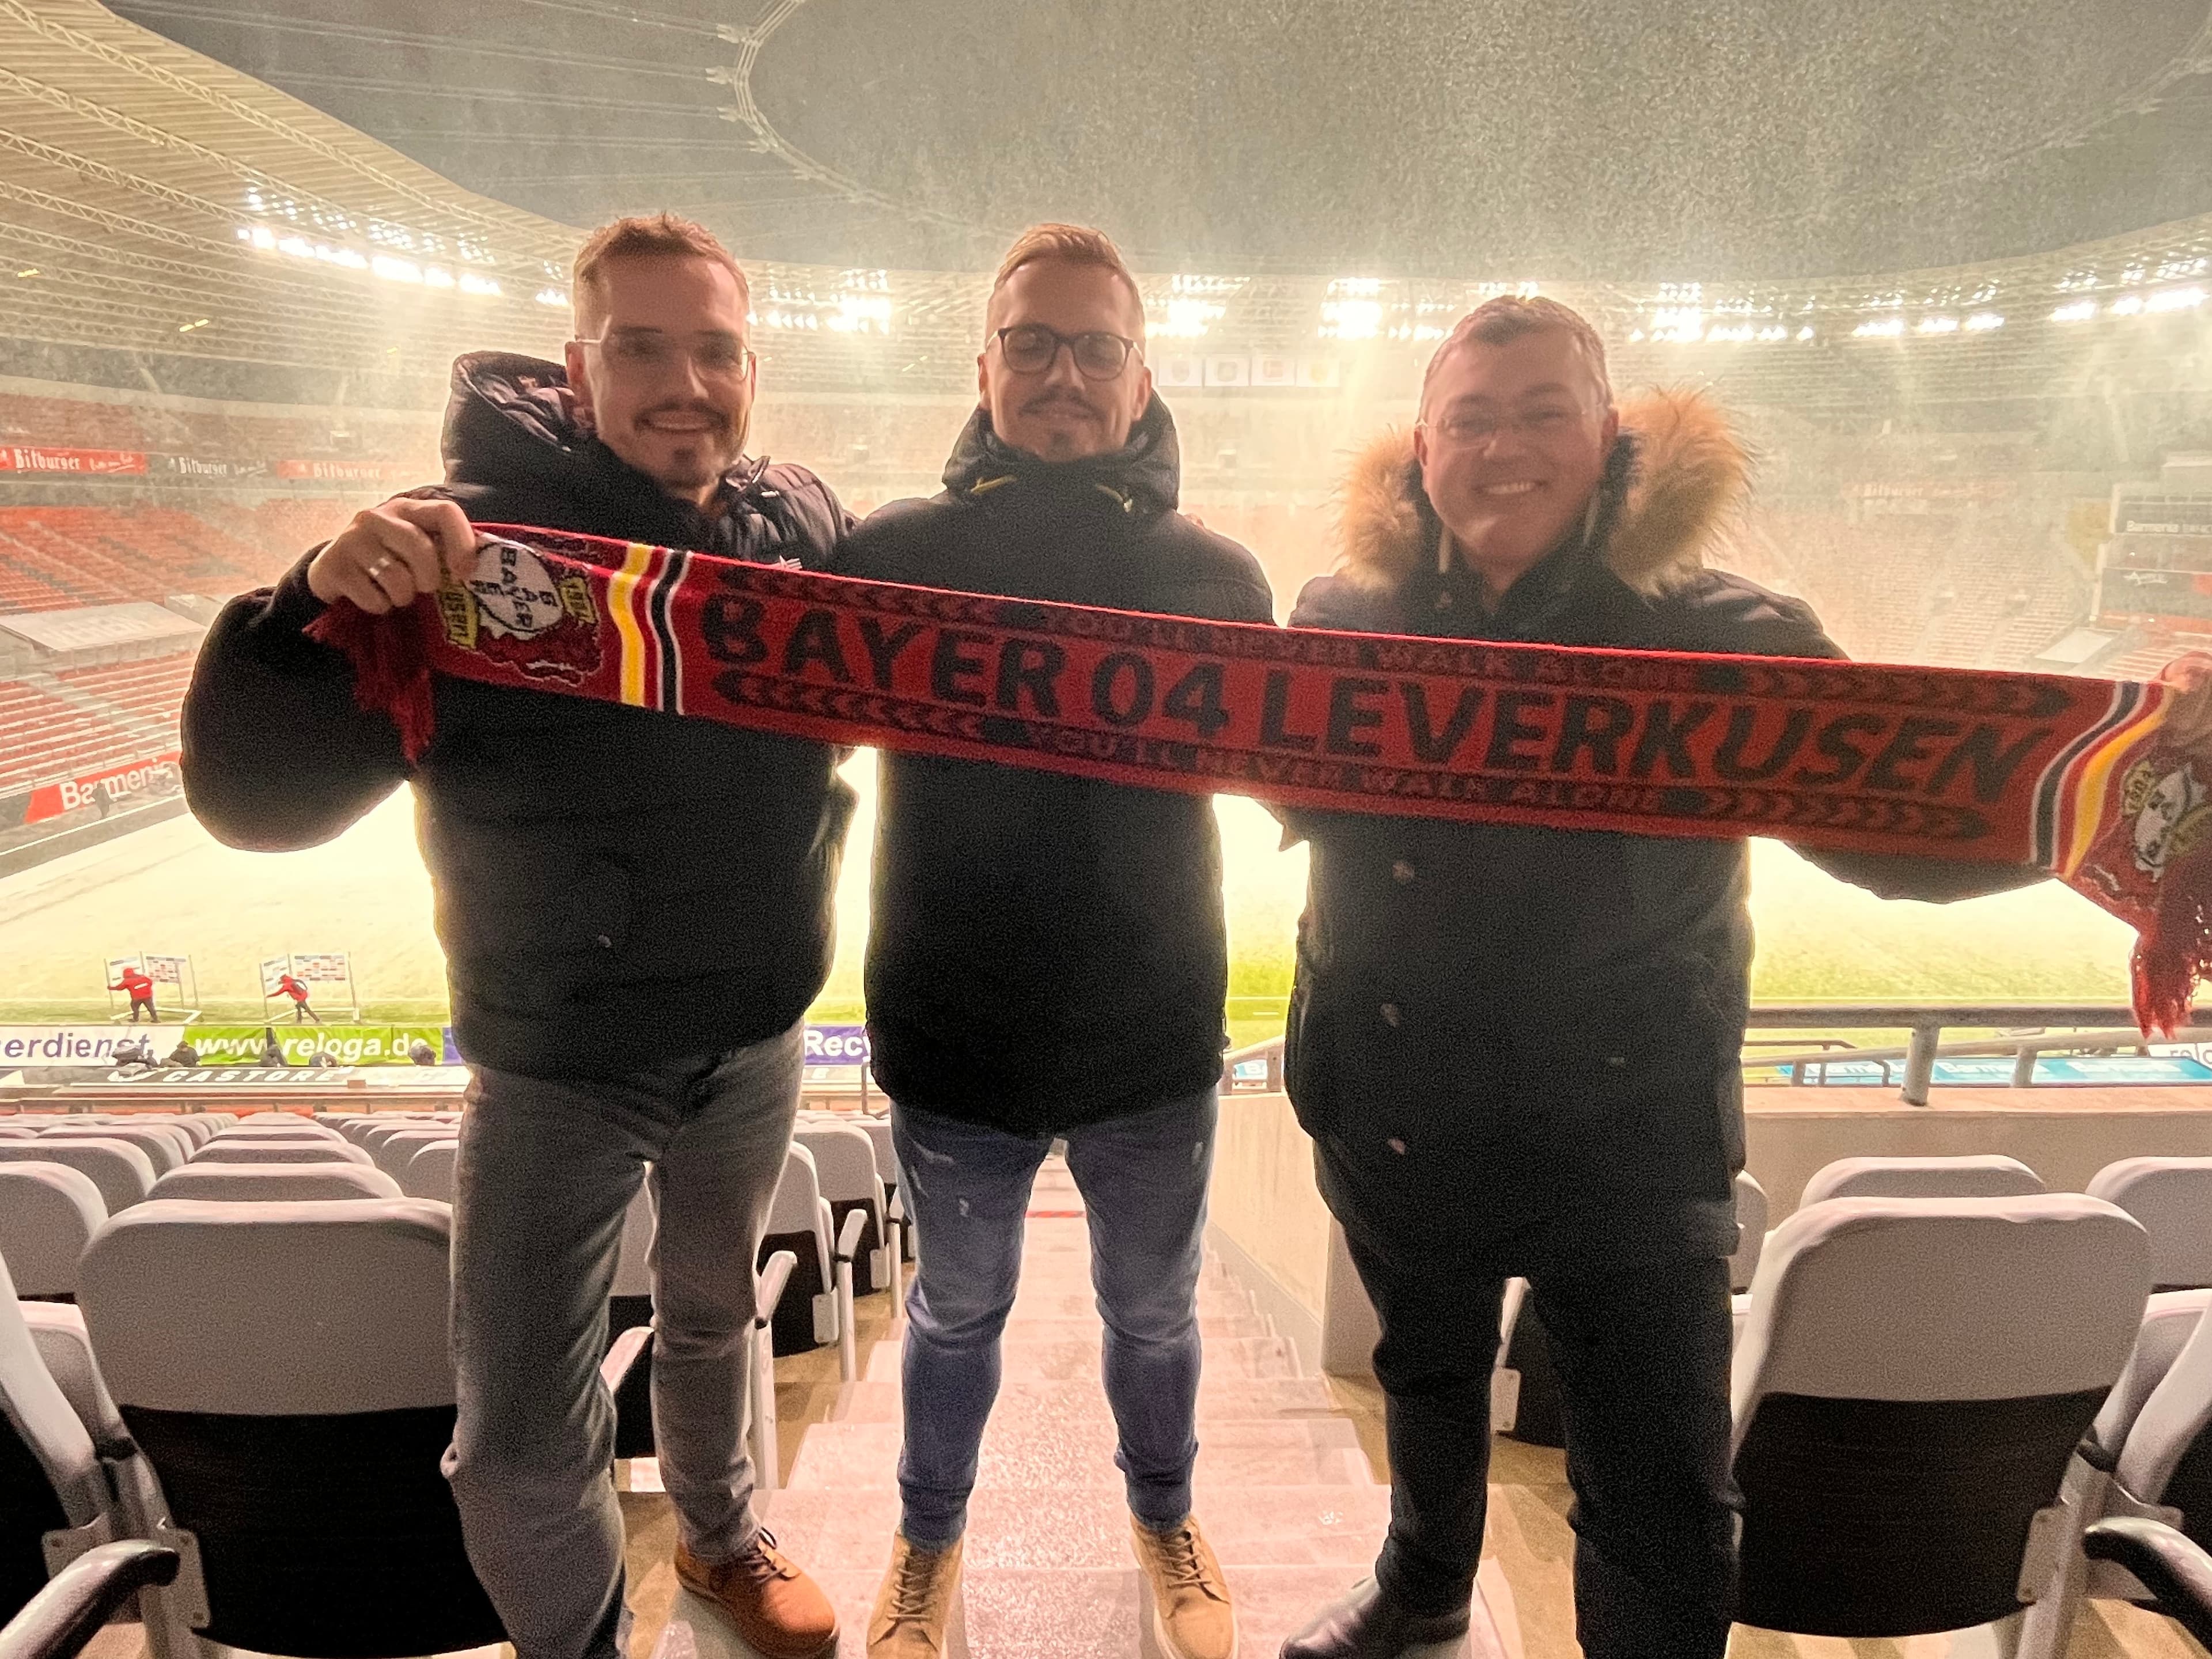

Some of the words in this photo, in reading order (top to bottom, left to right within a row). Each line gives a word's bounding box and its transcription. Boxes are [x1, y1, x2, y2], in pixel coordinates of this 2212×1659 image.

[14, 449, 81, 471] Bitburger
[179, 456, 228, 478] Bitburger
[701, 593, 1066, 718] BAYER
[1091, 651, 1231, 740] 04
[1259, 669, 2055, 803] LEVERKUSEN
[59, 757, 176, 810] Bameni
[162, 1070, 336, 1082] CASTORE
